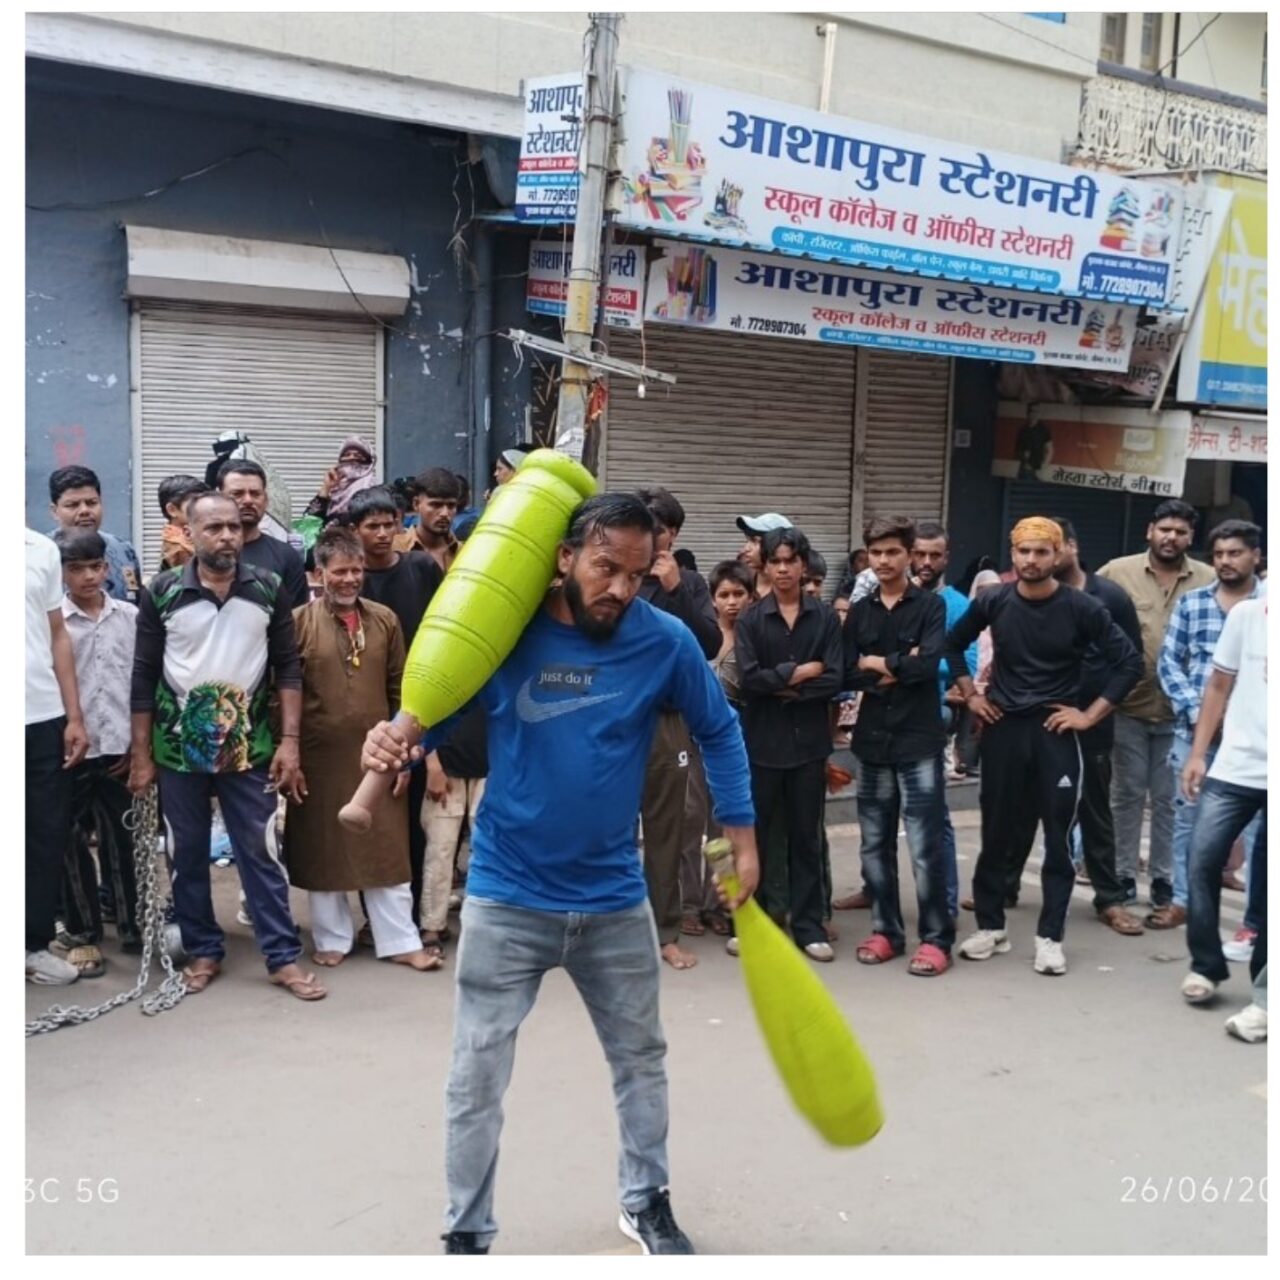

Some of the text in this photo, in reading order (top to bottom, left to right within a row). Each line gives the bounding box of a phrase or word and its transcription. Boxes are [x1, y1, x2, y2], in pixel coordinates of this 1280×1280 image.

[718, 109, 1101, 220] आशापुरा स्टेशनरी
[763, 186, 1075, 263] स्कूल कॉलेज व ऑफीस स्टेशनरी
[734, 260, 1085, 327] आशापुरा स्टेशनरी
[811, 306, 855, 327] स्कूल
[859, 308, 911, 332] कॉलेज
[915, 320, 927, 334] व
[933, 319, 986, 340] ऑफीस
[990, 326, 1047, 346] स्टेशनरी
[538, 670, 593, 685] just do it
